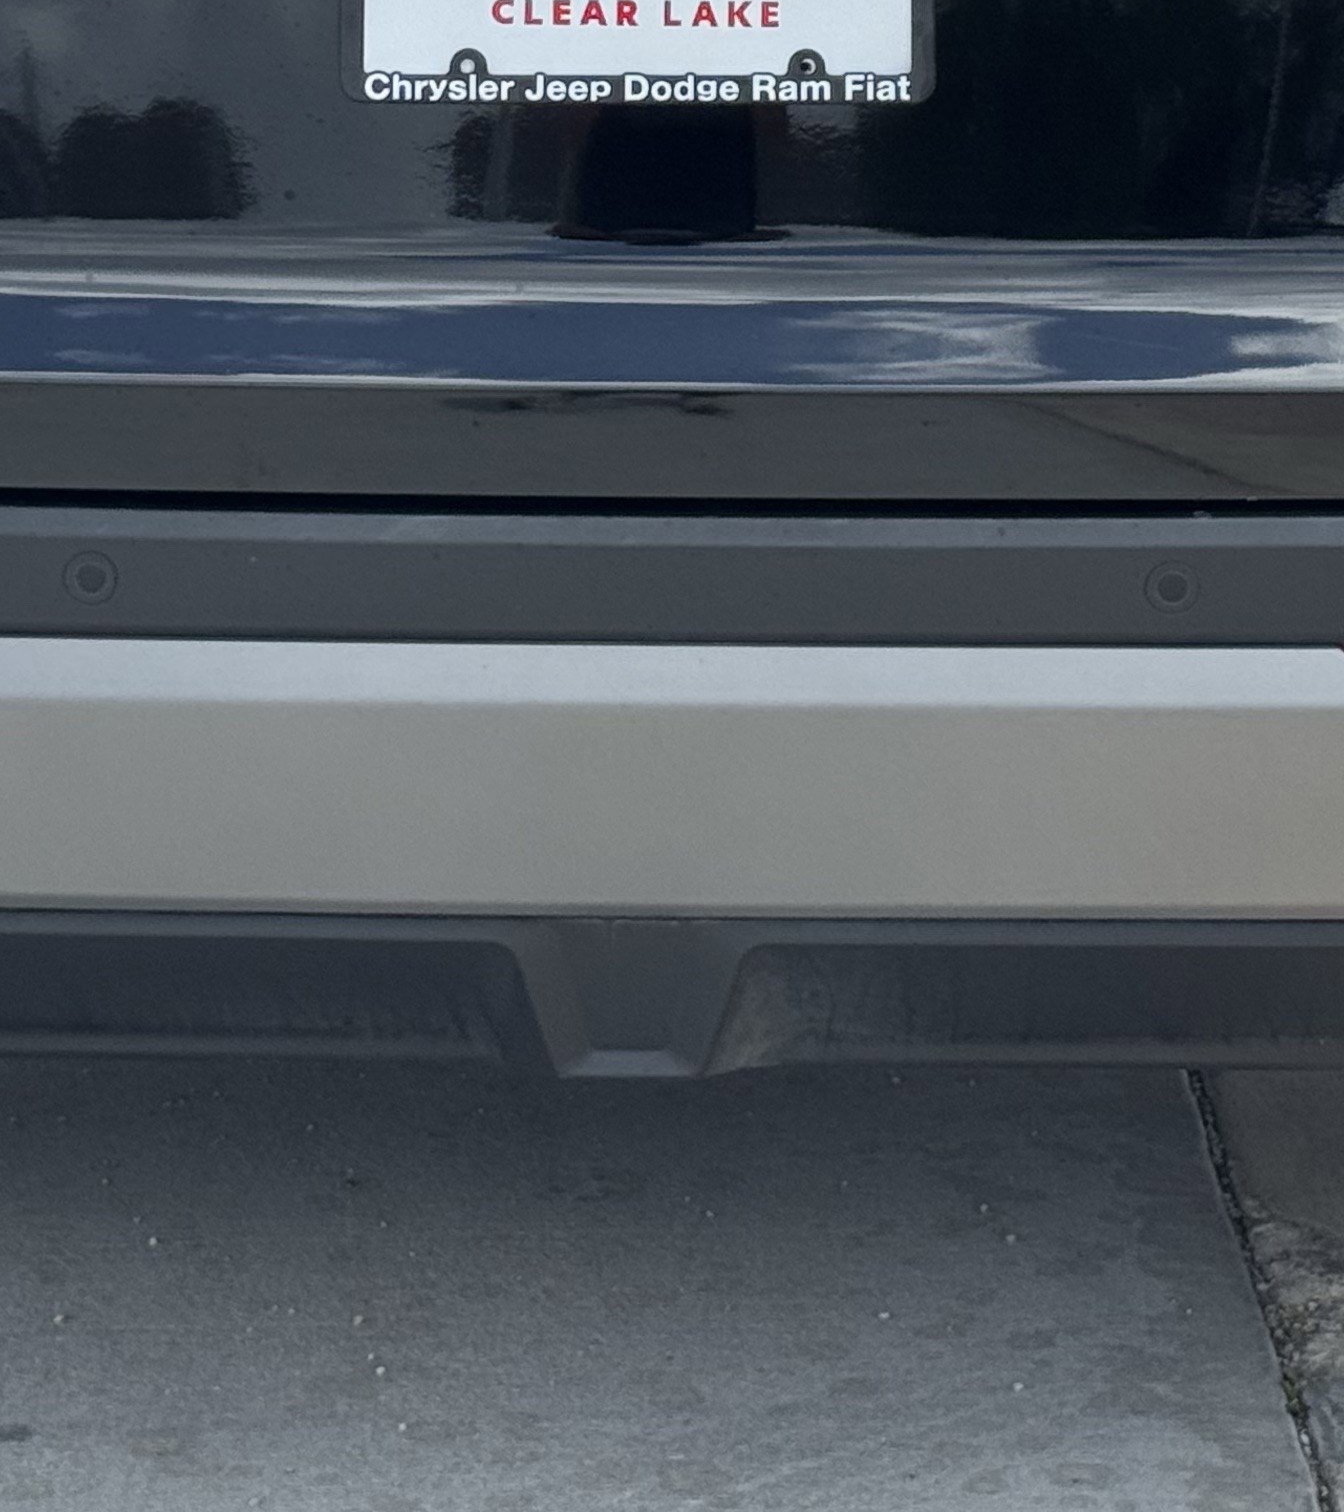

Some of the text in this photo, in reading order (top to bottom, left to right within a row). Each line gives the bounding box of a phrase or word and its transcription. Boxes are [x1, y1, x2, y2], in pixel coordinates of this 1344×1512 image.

[663, 0, 780, 28] LAKE
[364, 72, 912, 103] Chrysler Jeep Dodge Ram Fiat
